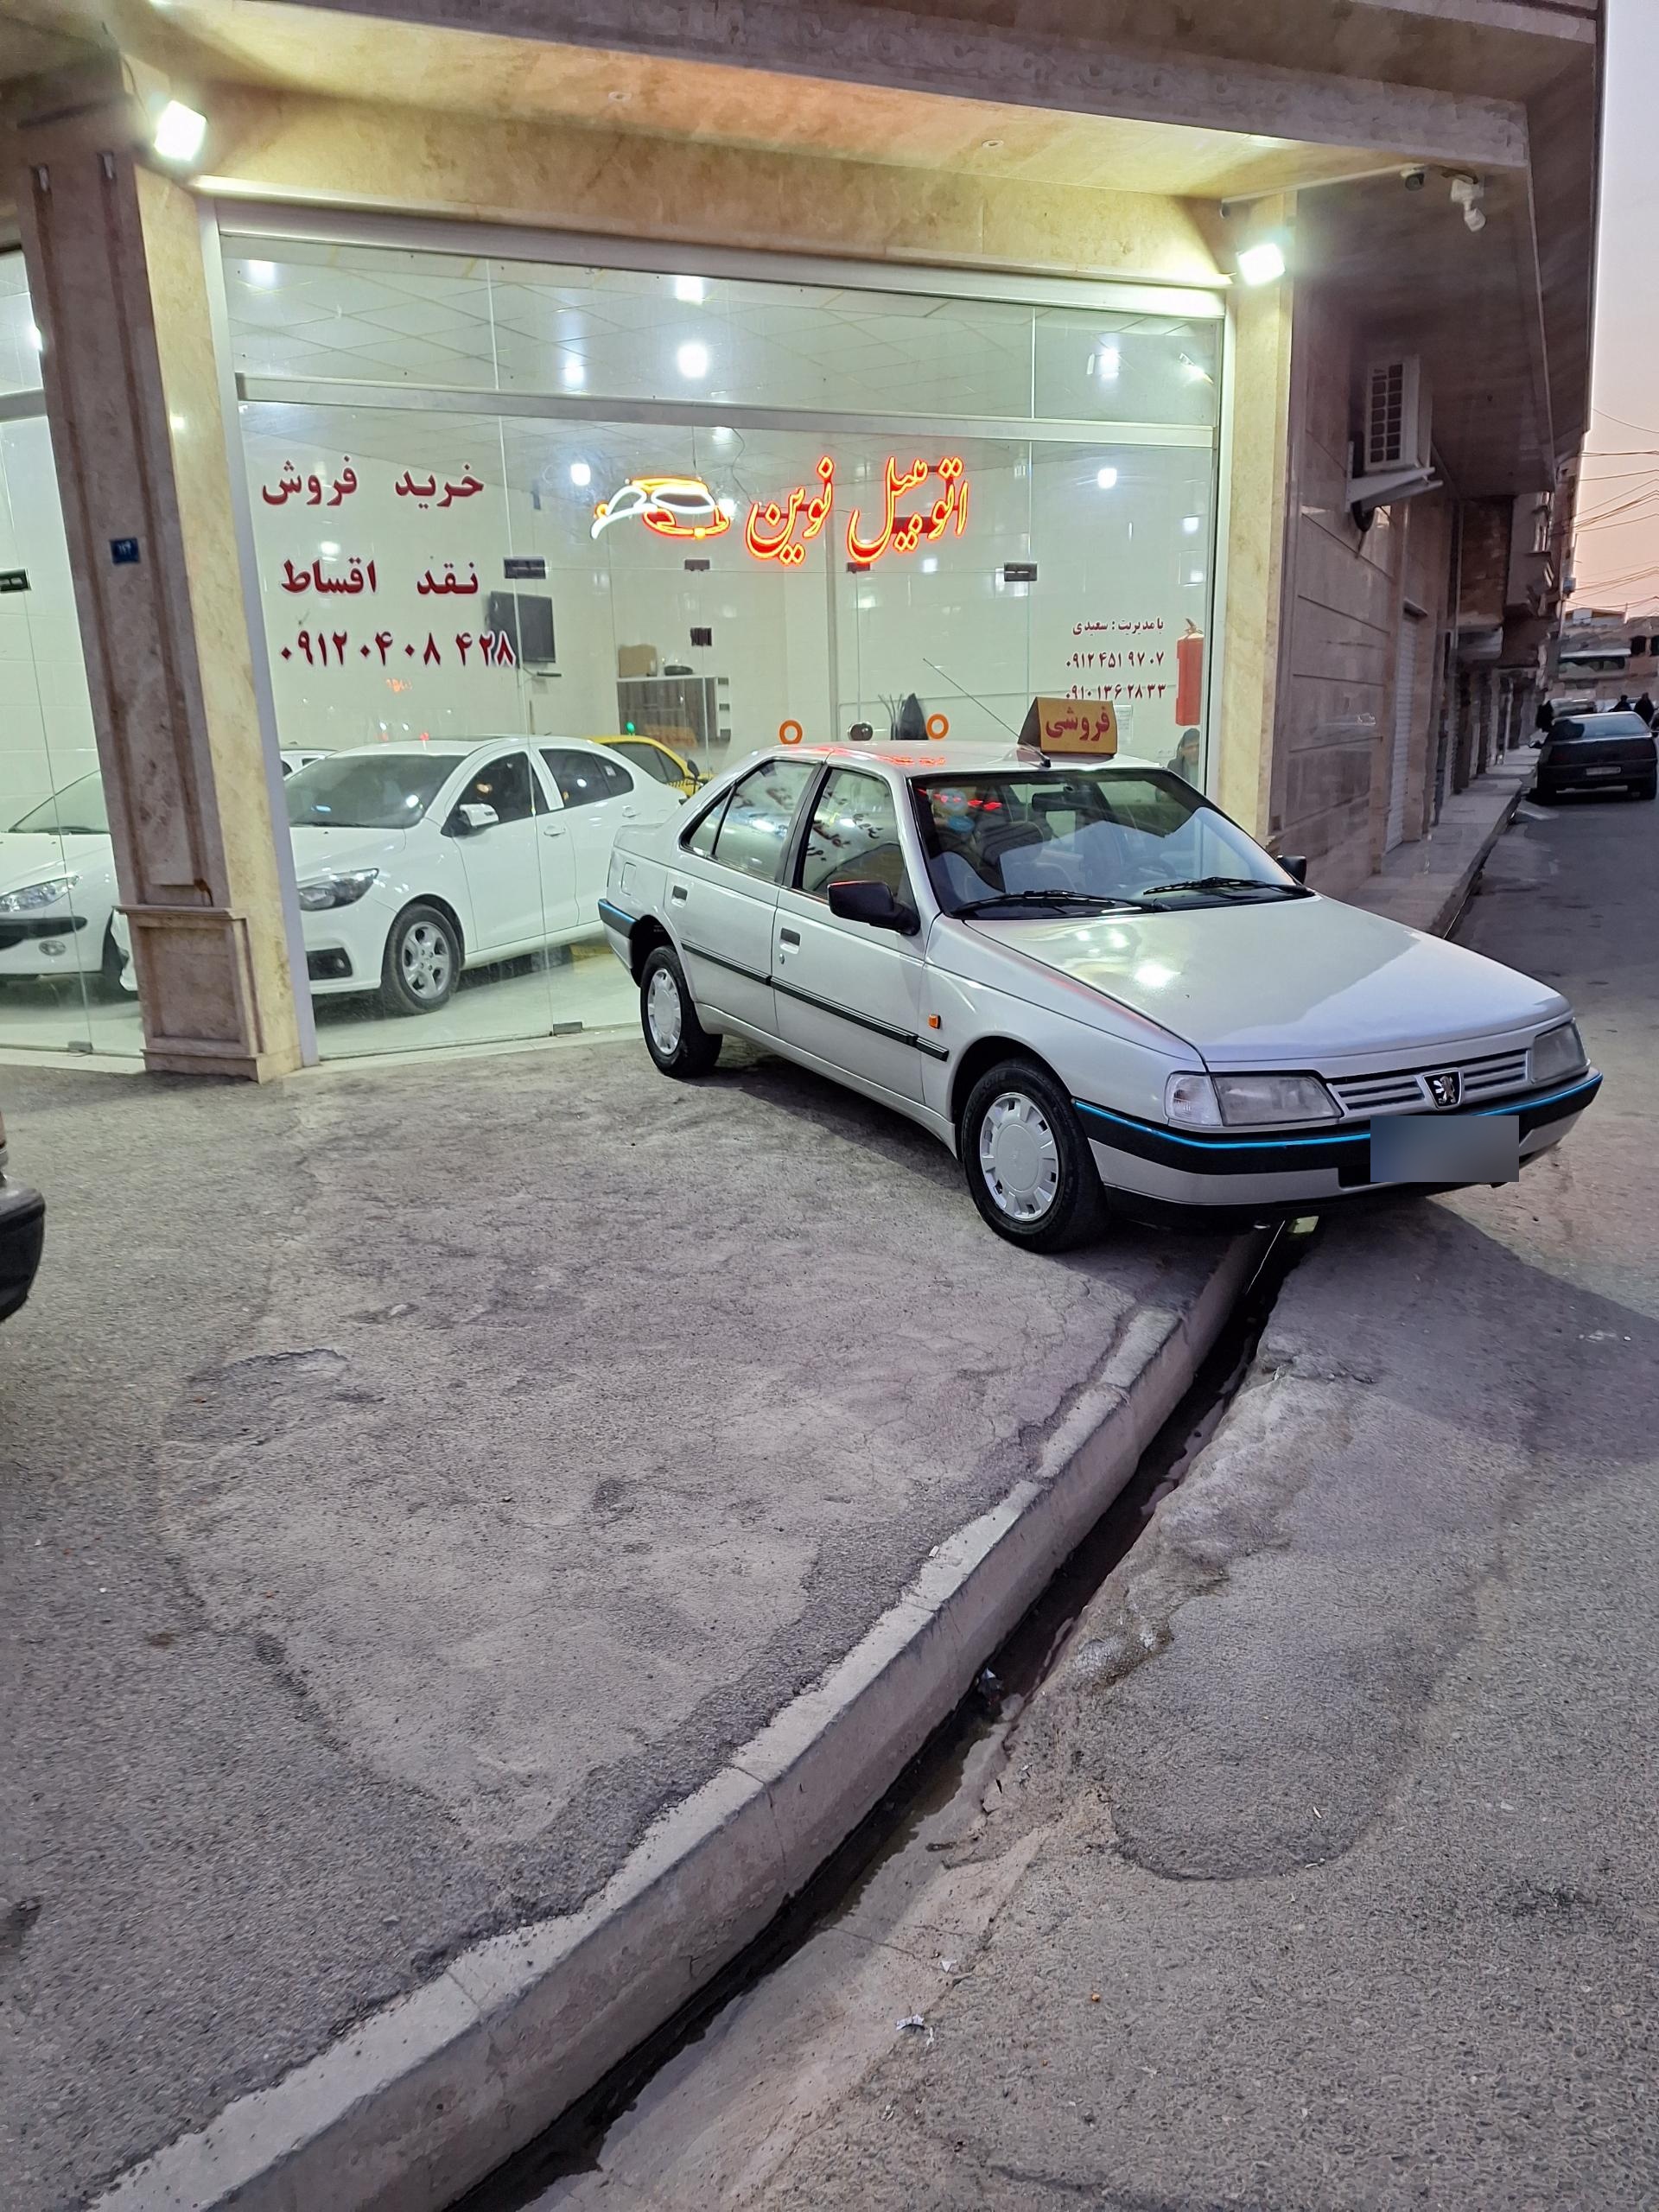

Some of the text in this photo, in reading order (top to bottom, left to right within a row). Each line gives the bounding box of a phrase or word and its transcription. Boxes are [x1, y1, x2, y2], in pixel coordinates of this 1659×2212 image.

[262, 454, 485, 510] خرید فروش
[745, 455, 835, 565] نوین
[280, 556, 480, 595] نقد اقساط
[1072, 621, 1109, 637] سعیدی
[1117, 620, 1155, 636] مدیریت
[1046, 705, 1111, 741] فروشی
